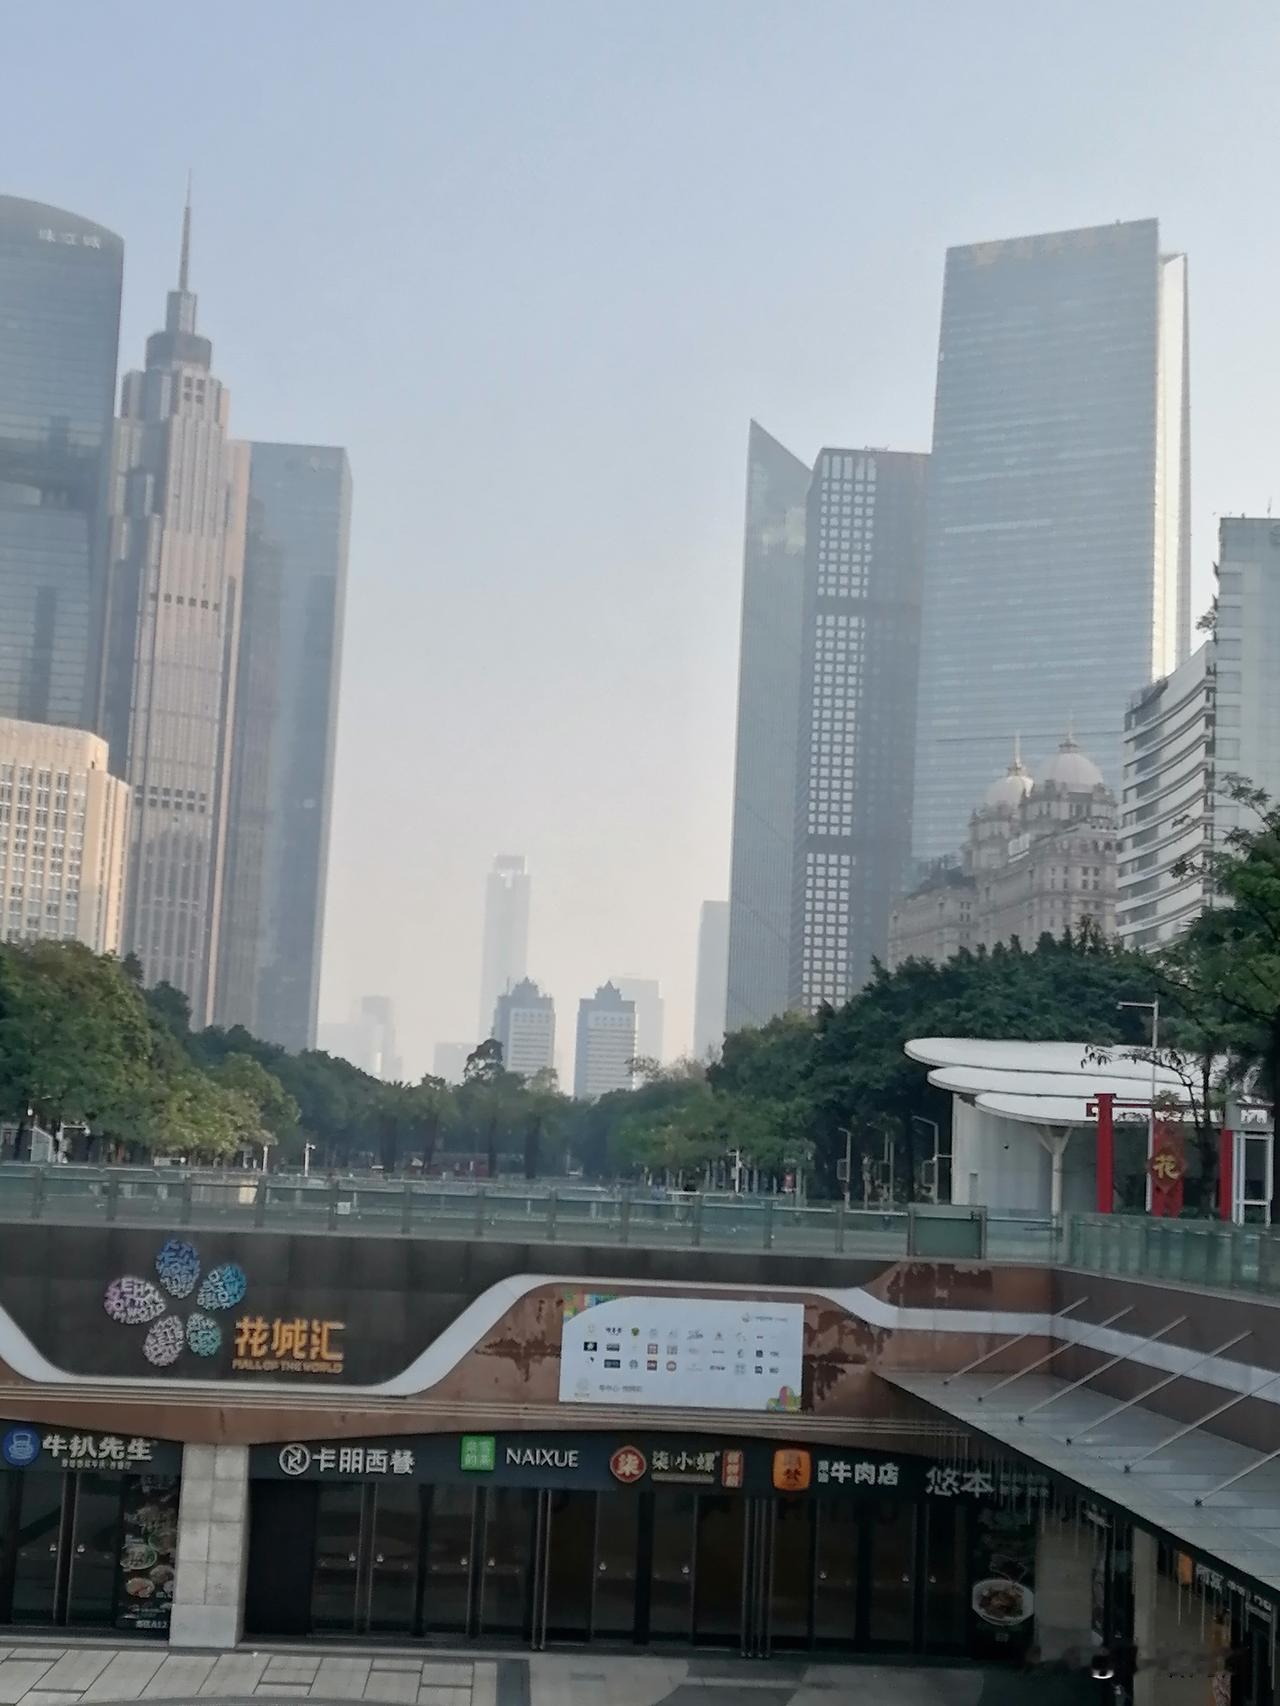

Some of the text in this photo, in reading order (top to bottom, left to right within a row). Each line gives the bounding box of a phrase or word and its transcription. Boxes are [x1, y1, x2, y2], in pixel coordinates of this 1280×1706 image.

[1152, 1153, 1182, 1179] 花
[234, 1316, 345, 1360] 花城汇
[42, 1434, 152, 1461] 牛扒先生
[507, 1447, 579, 1468] NAIXUE
[829, 1460, 899, 1486] 牛肉店
[925, 1466, 995, 1498] 悠本
